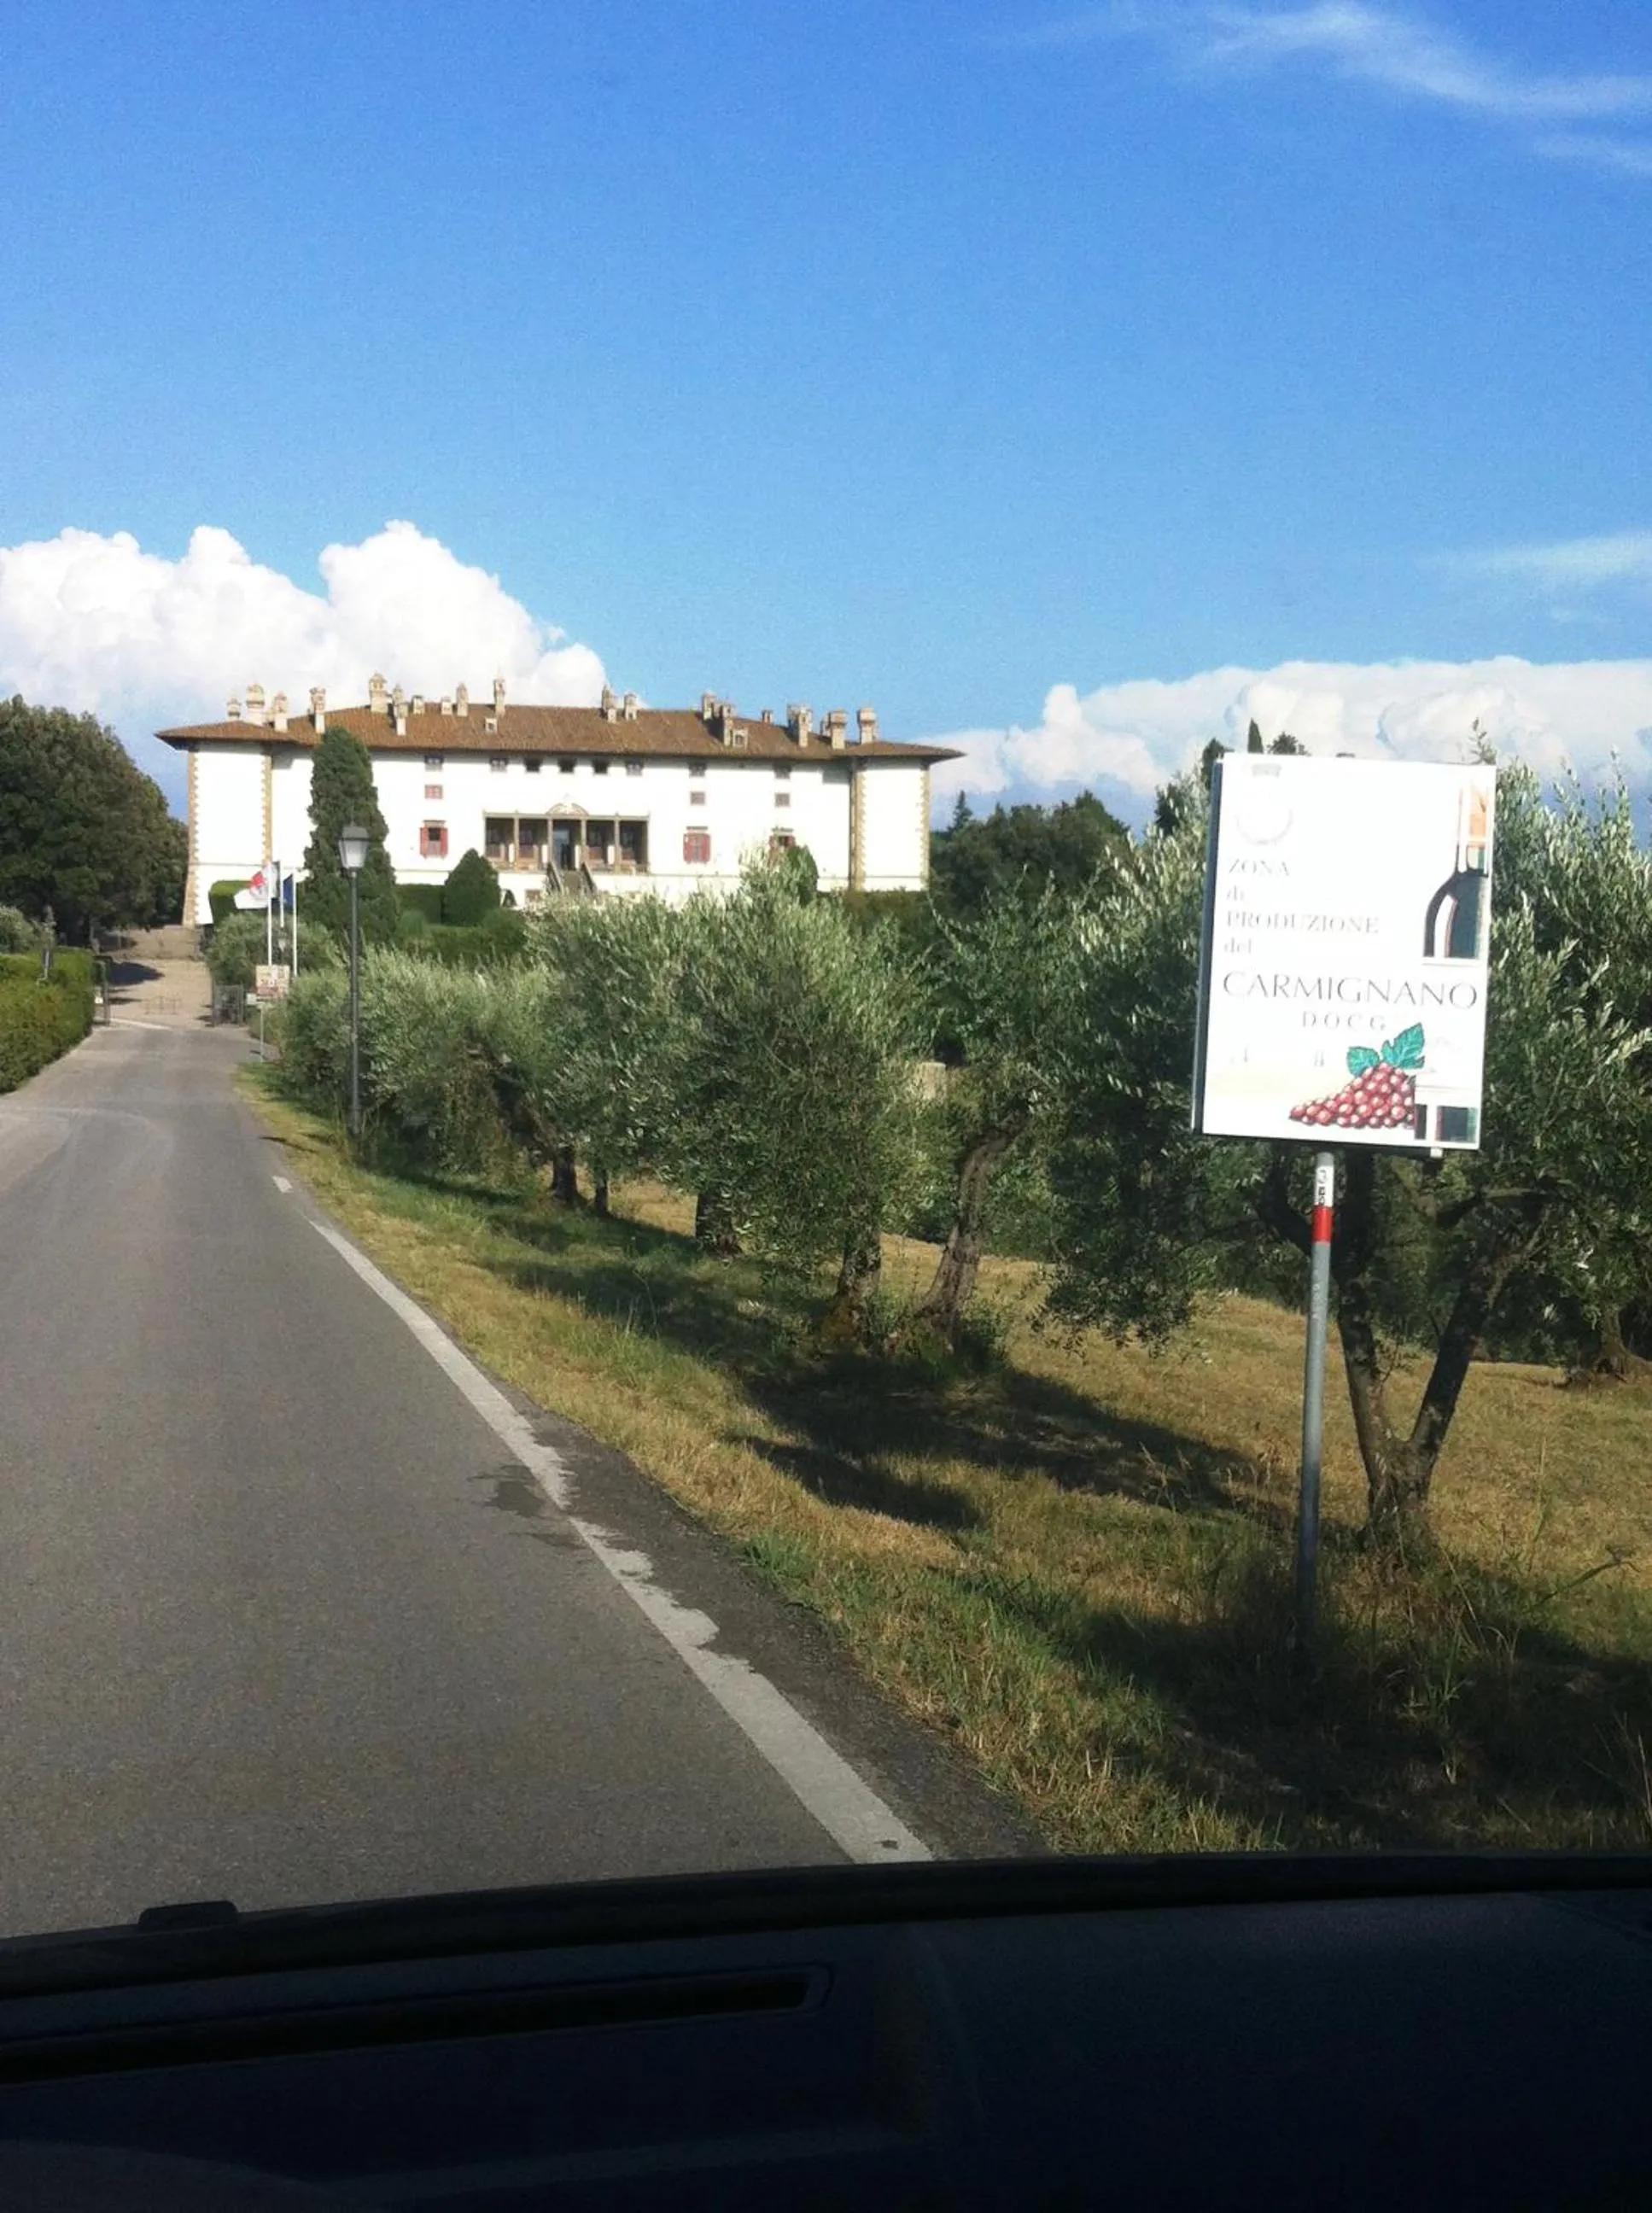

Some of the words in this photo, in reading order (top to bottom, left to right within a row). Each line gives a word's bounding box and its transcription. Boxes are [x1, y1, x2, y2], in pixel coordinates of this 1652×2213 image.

[1228, 857, 1290, 878] ZONA
[1226, 885, 1246, 902] di
[1226, 910, 1380, 935] PRODUZIONE
[1223, 937, 1252, 955] del
[1223, 971, 1478, 1010] CARMIGNANO
[1302, 1011, 1386, 1032] DOCG
